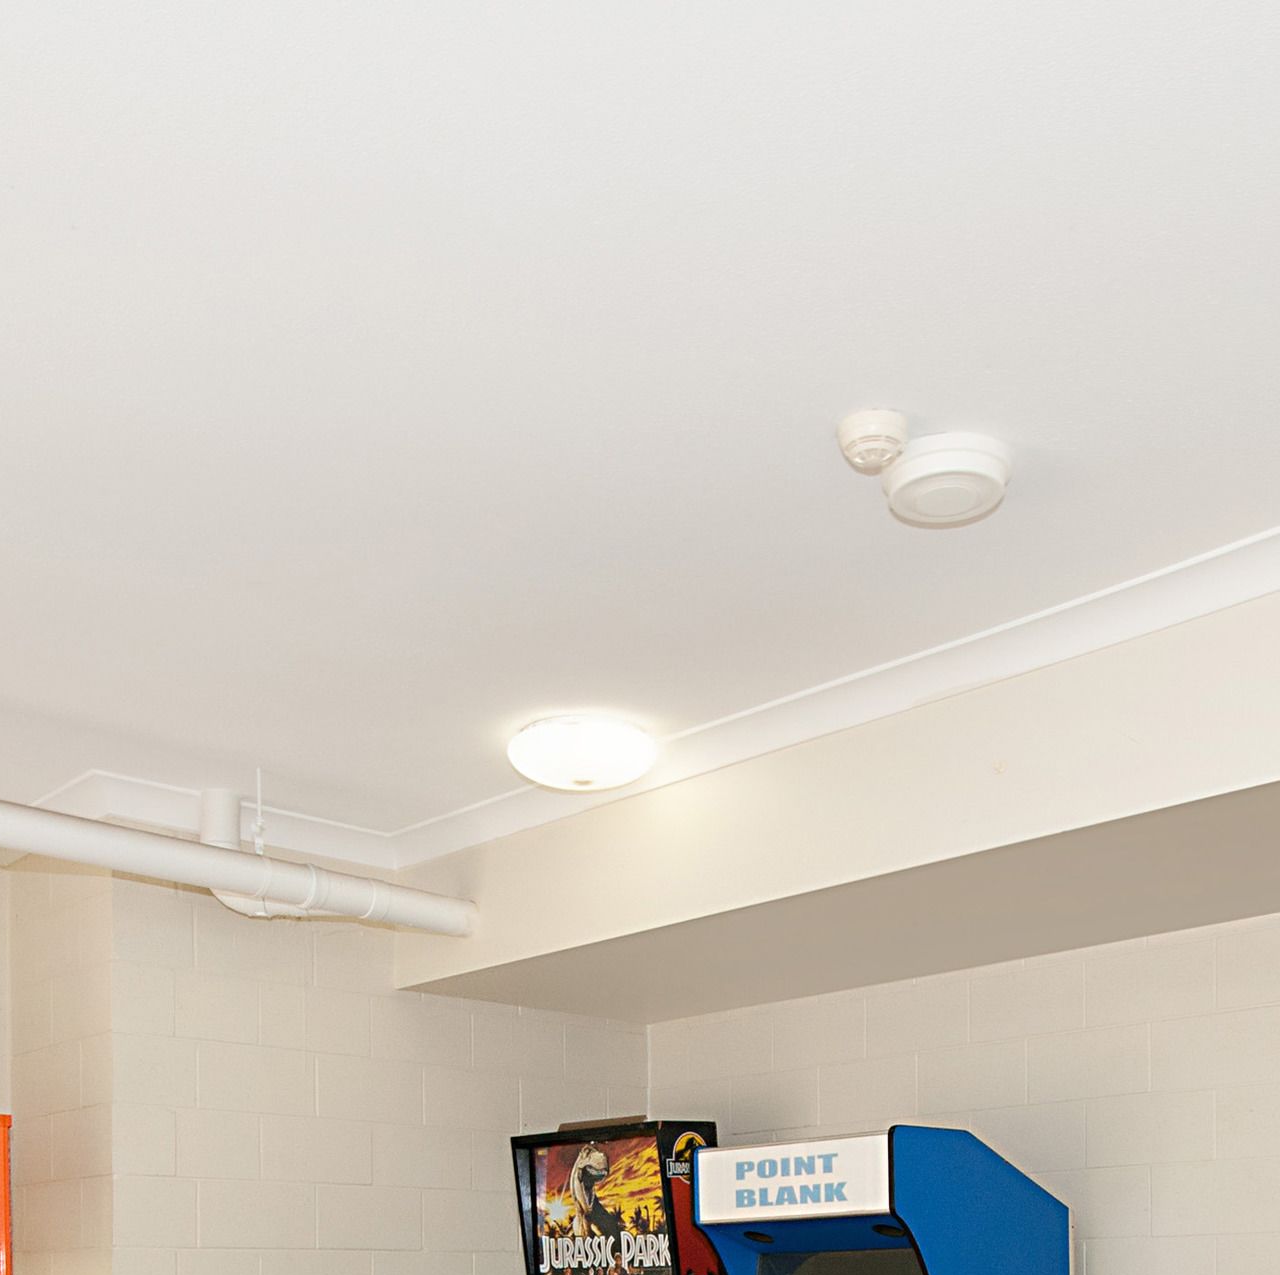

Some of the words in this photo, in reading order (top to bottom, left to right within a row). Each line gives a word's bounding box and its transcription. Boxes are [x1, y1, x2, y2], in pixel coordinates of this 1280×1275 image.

[735, 1153, 838, 1181] POINT
[735, 1182, 848, 1208] BLANK
[539, 1234, 617, 1273] JURASSIC
[620, 1231, 672, 1269] PARK
